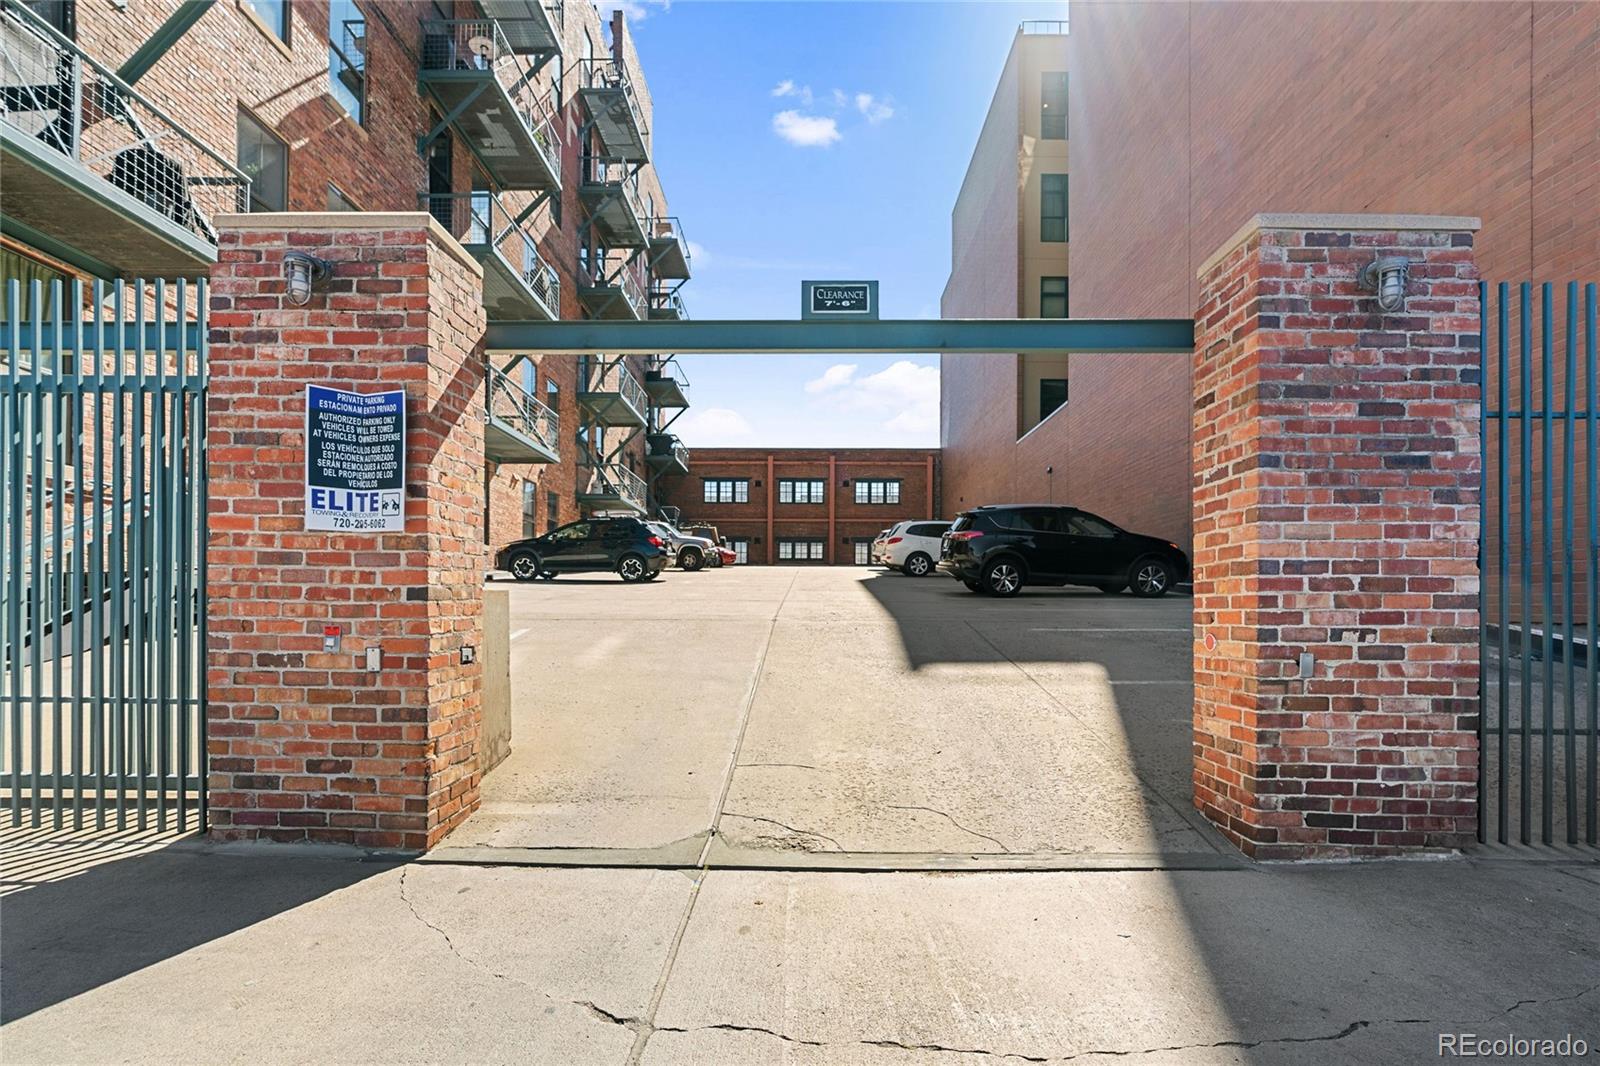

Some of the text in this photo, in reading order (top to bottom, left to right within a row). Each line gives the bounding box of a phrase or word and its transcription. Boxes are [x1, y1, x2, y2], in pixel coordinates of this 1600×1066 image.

[337, 393, 385, 405] PRIVATE PARKING
[376, 404, 397, 413] PRIVADO
[318, 412, 396, 426] AUTHORIZED PARKING ONLY
[321, 421, 394, 435] VEHICLES WILL BE TOWED
[313, 428, 401, 443] AT VEHICLES OWNERS EXPENSE
[321, 441, 395, 455] LOS VEHÍCULOS QUE SOLO
[322, 451, 394, 463] ESTACIONEN AUTORIZADO
[342, 461, 377, 471] REMOLQUES
[381, 461, 398, 470] COSTO
[323, 468, 394, 480] DEL PROPIETARIO DE LOS
[311, 488, 380, 512] ELITE
[312, 510, 340, 518] TOWING
